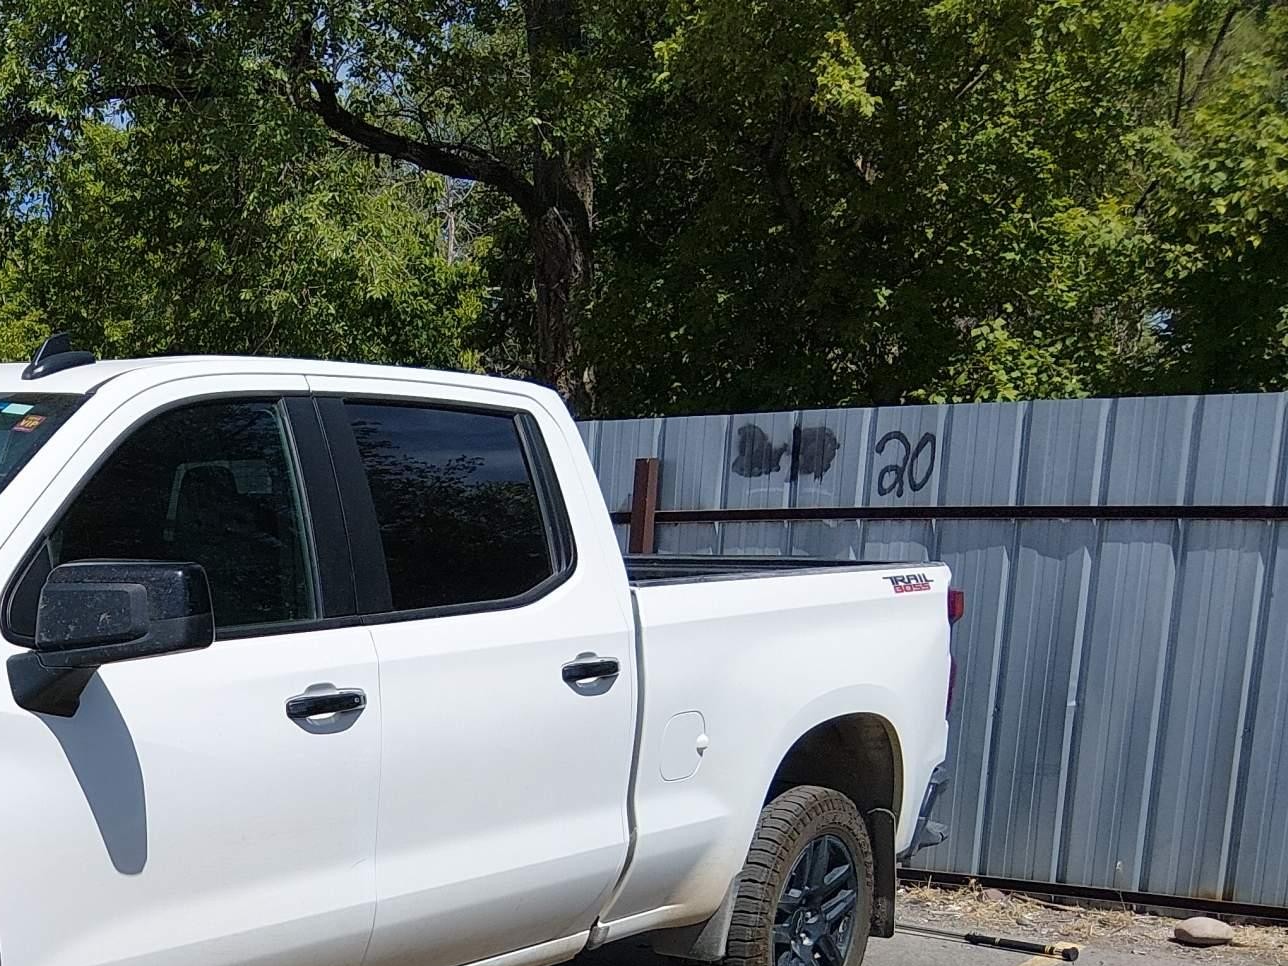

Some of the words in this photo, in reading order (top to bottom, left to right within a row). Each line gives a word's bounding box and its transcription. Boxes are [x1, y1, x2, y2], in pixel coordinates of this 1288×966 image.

[875, 430, 937, 498] 20
[882, 573, 934, 586] TRAIL
[894, 583, 931, 594] BOSS
